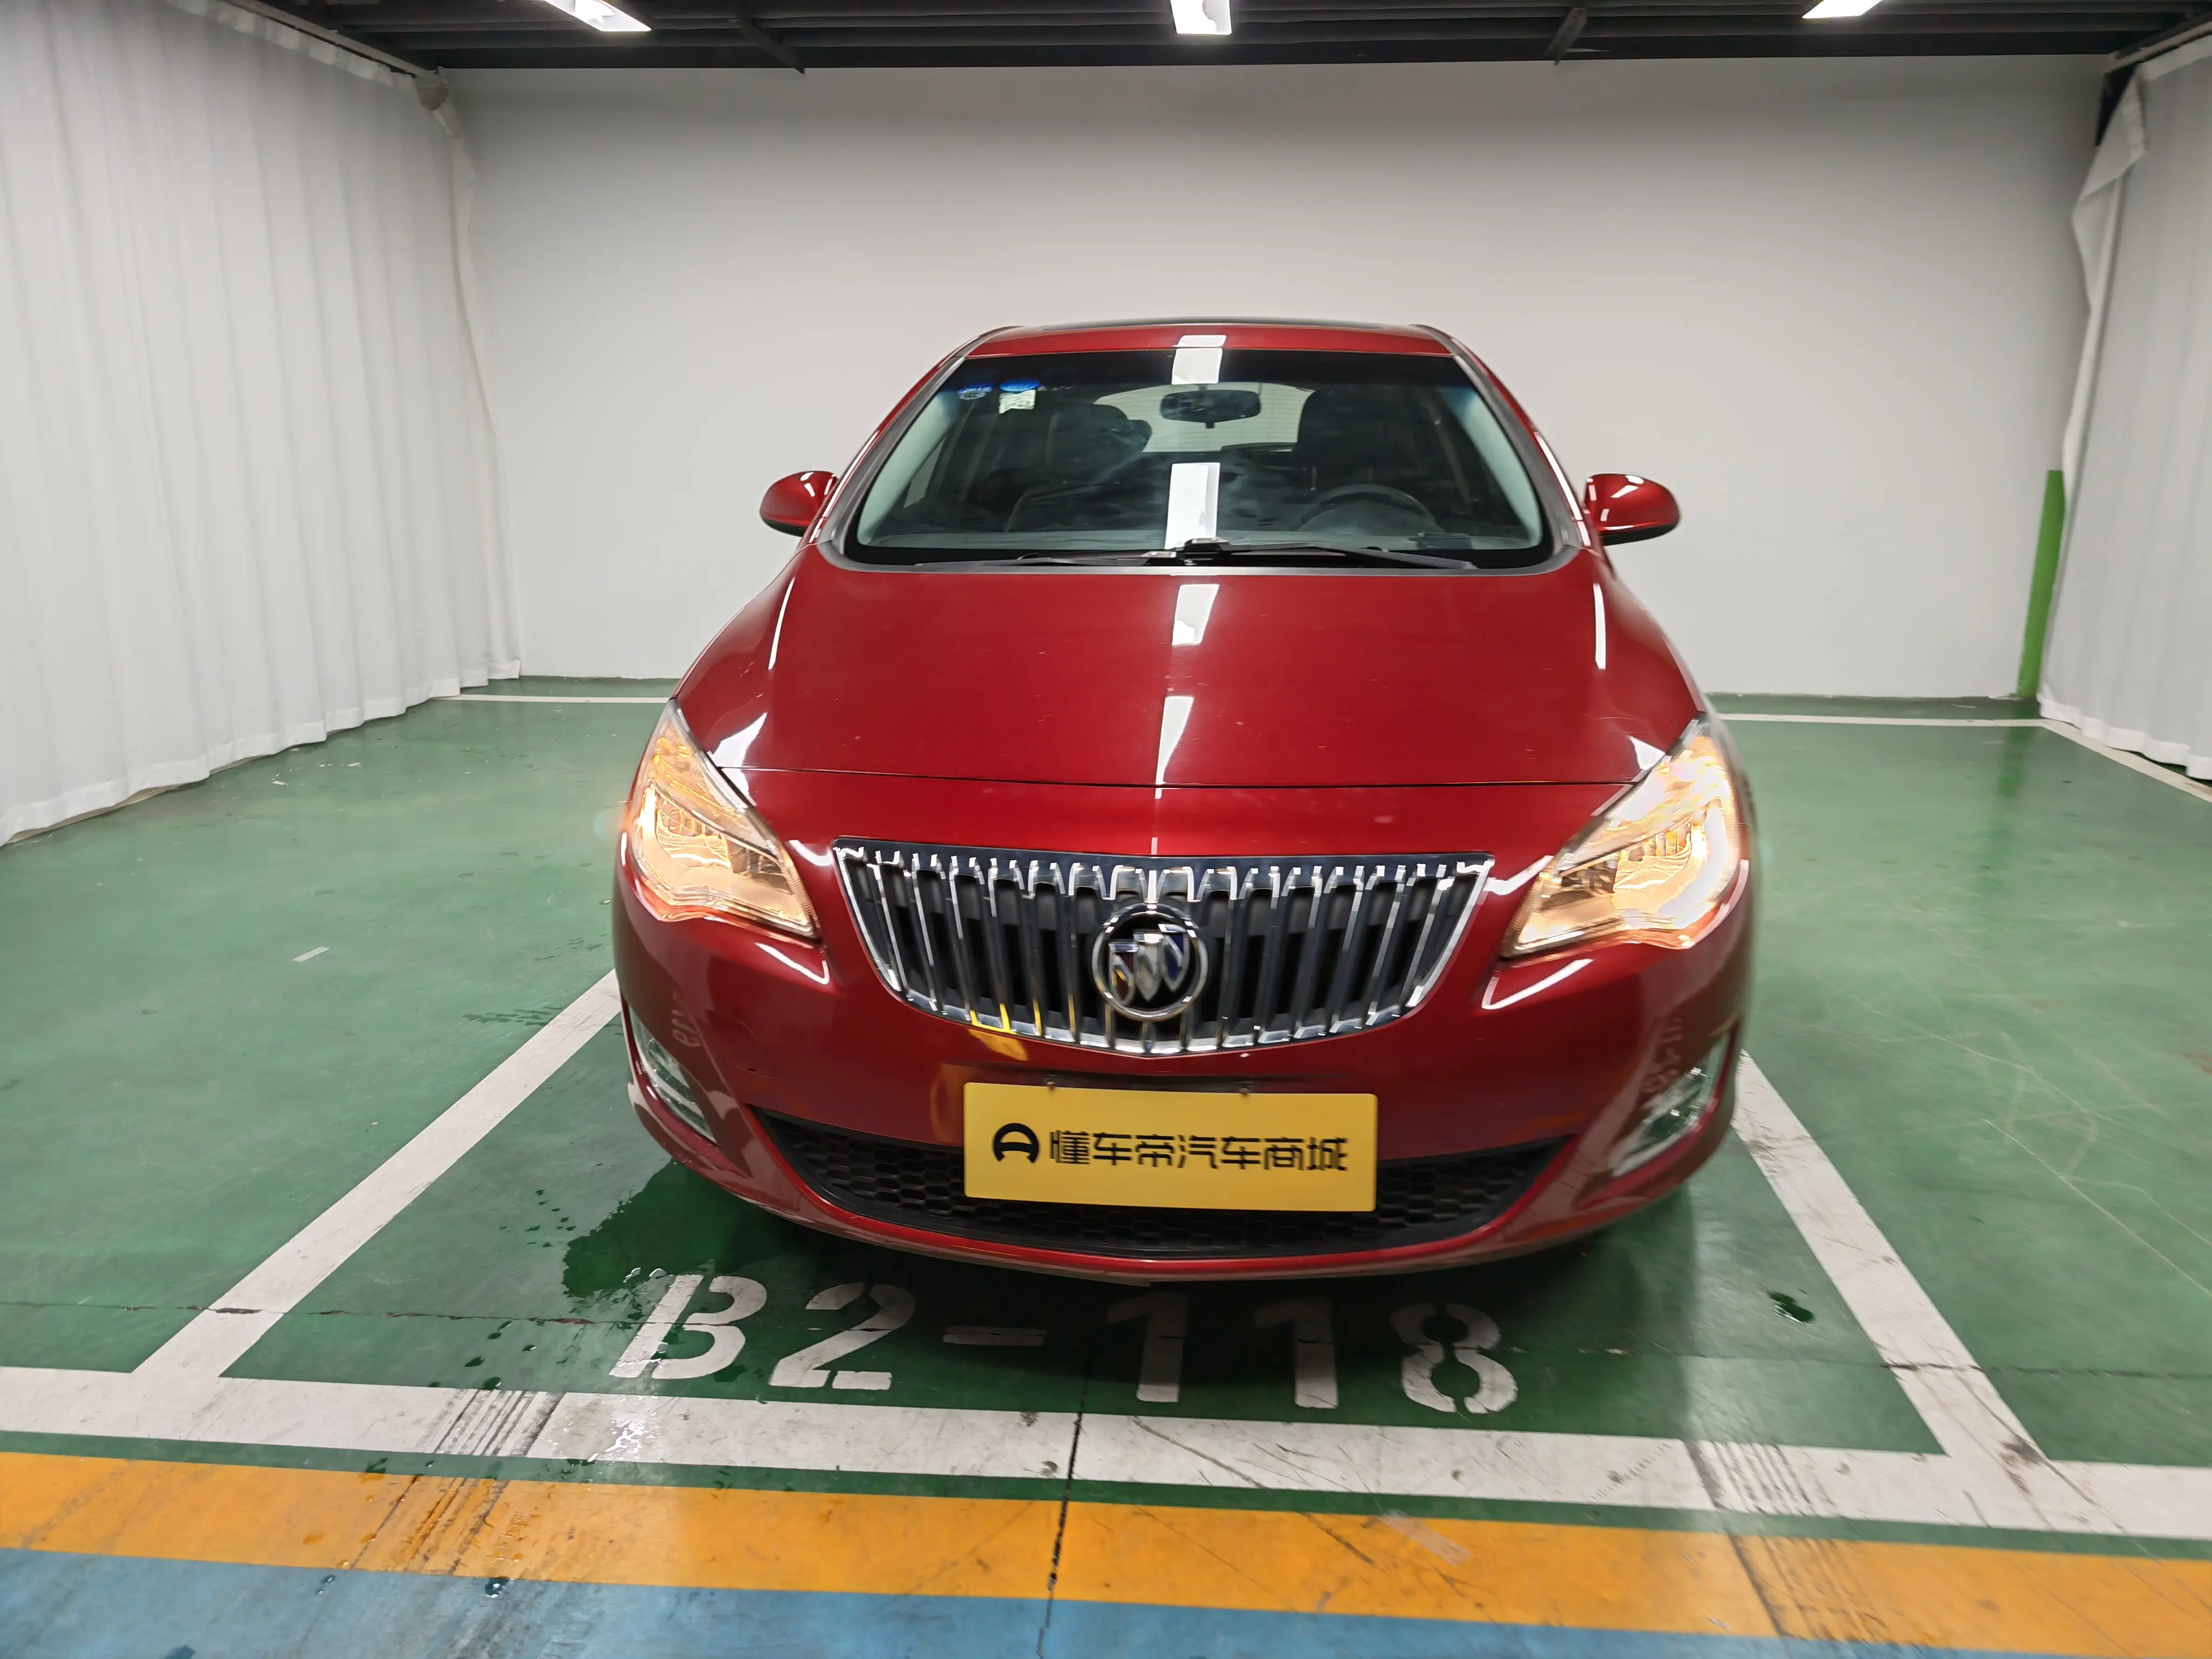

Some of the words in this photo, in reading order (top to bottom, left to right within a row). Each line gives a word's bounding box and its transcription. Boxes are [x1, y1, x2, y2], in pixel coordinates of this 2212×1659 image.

[1049, 1130, 1349, 1172] 懂车帝汽车商城
[608, 1274, 1519, 1415] B2-118
